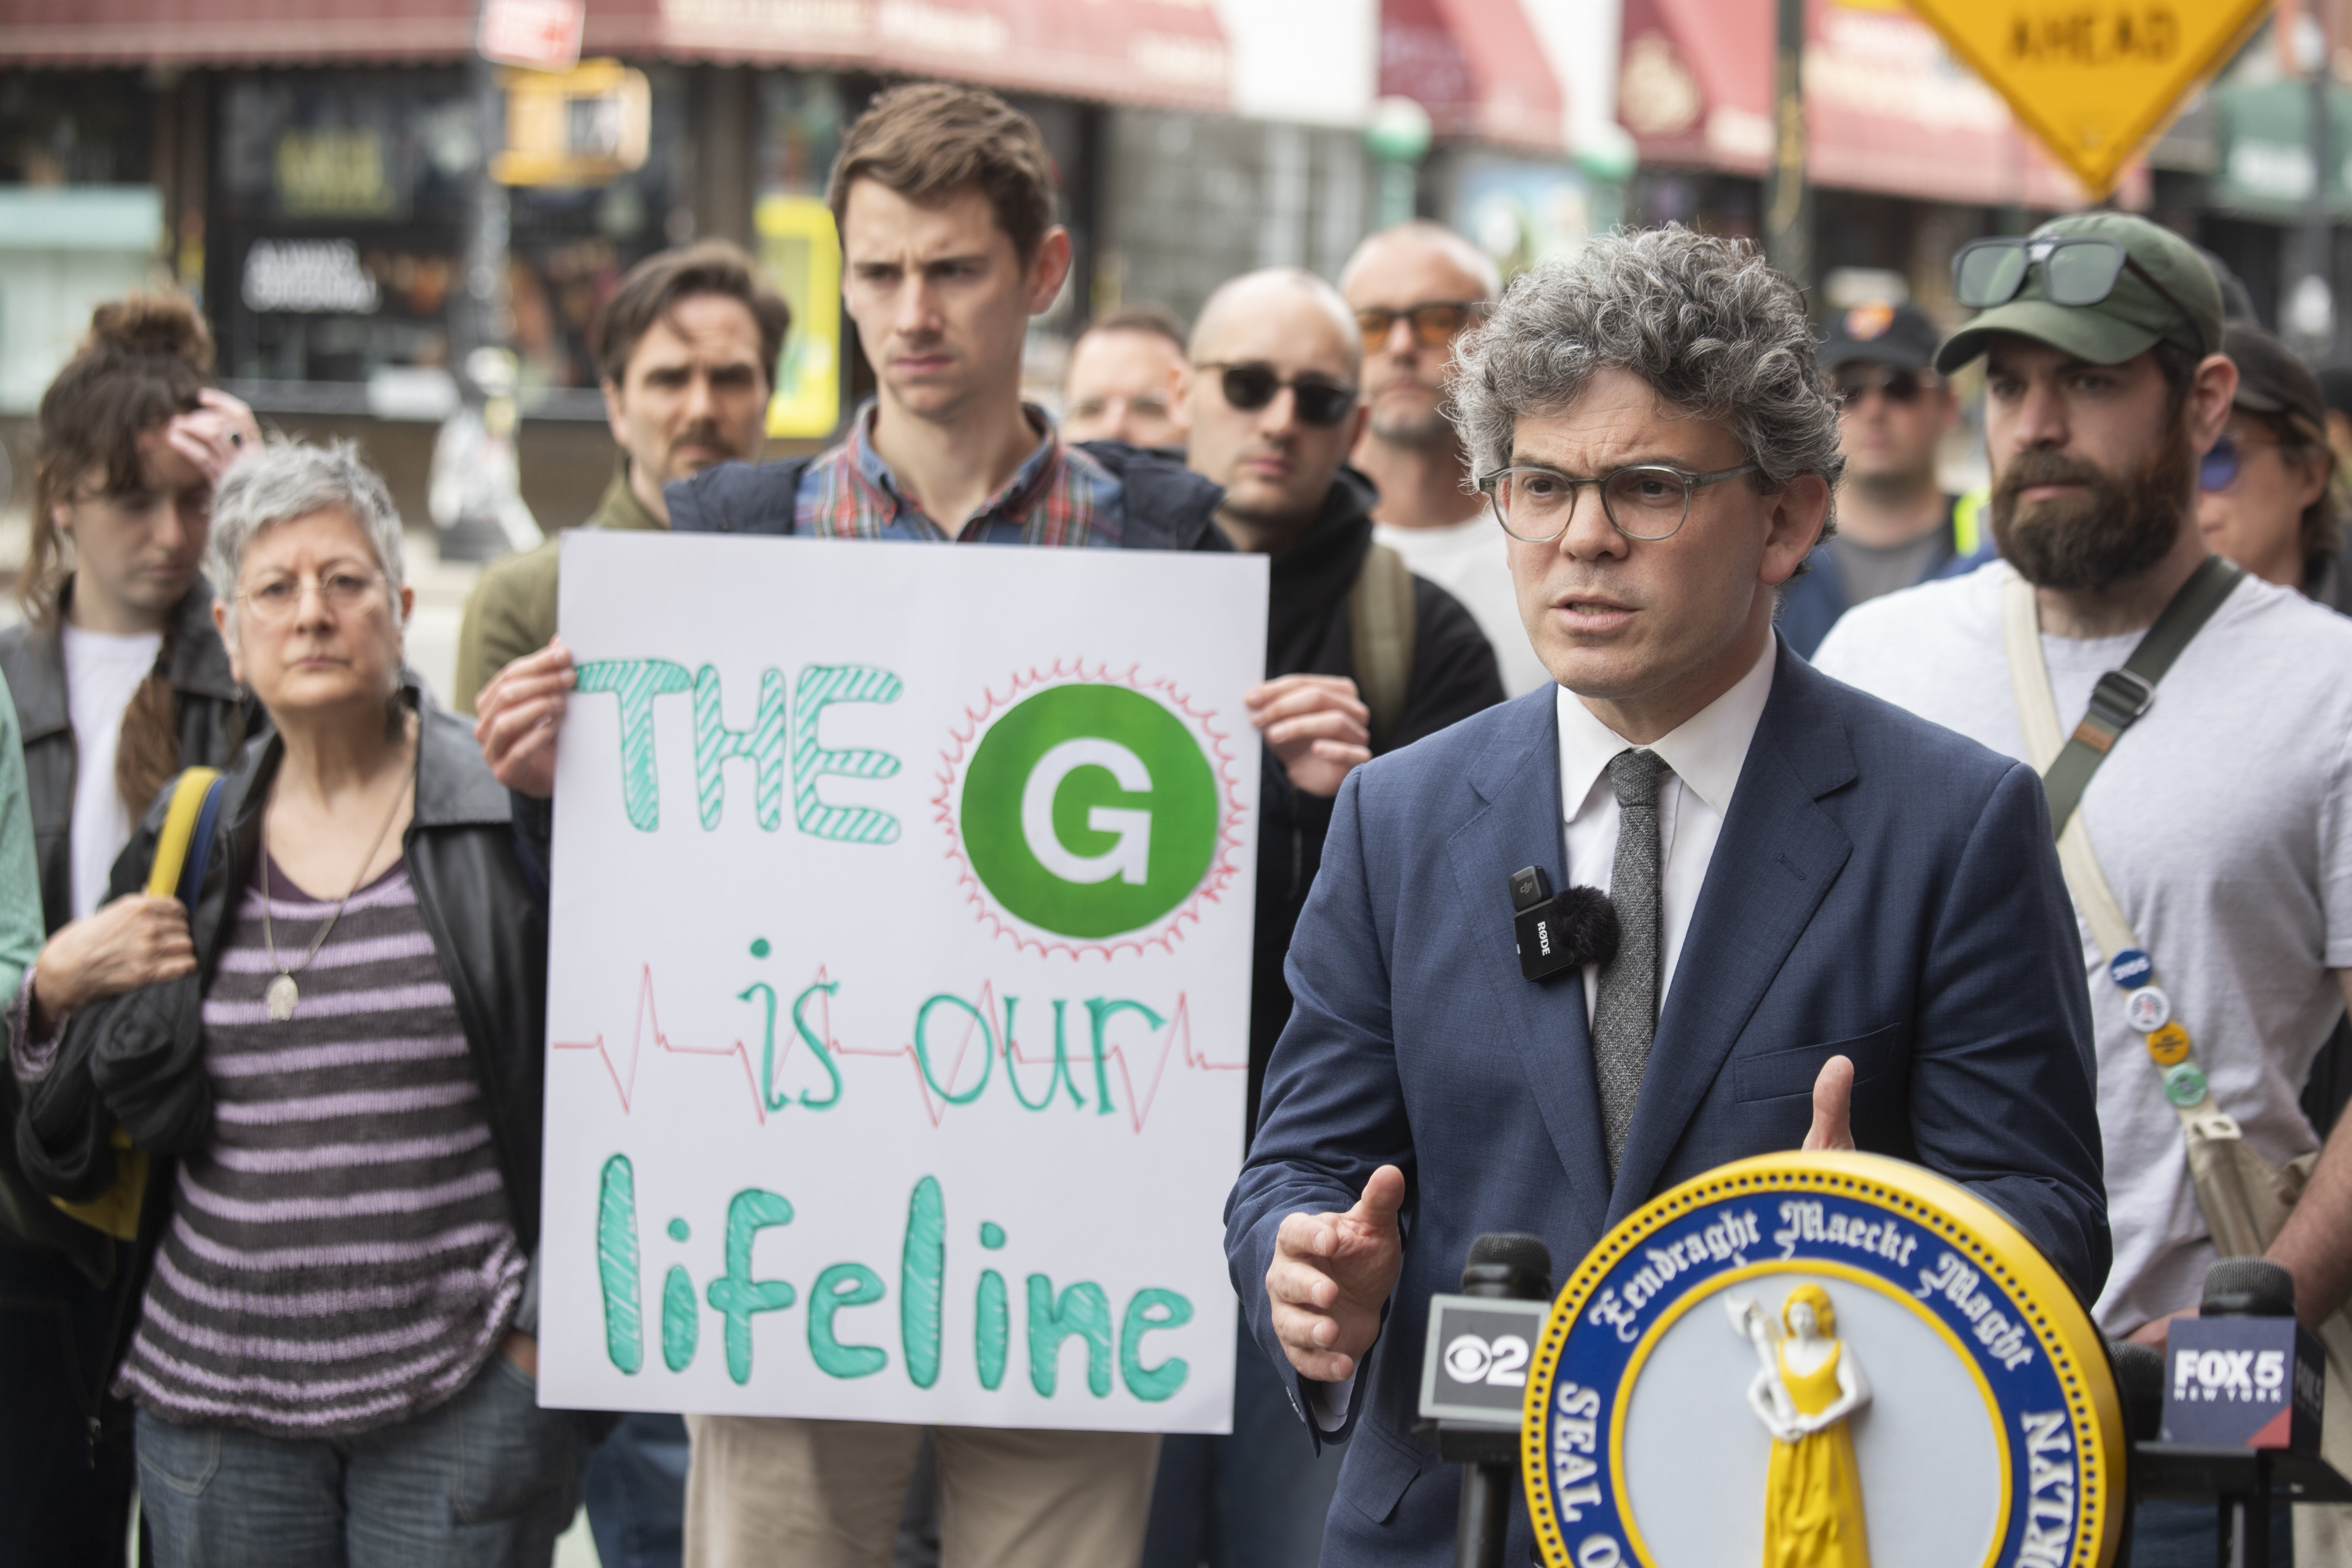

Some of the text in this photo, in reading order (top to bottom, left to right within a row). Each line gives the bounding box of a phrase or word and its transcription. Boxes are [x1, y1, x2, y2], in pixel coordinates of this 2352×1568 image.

[2009, 8, 2180, 64] AHEAD
[575, 658, 1153, 885] THE G
[735, 938, 1168, 1116] is our
[597, 1153, 1194, 1403] lifeline
[1553, 1380, 1602, 1523] SEAL
